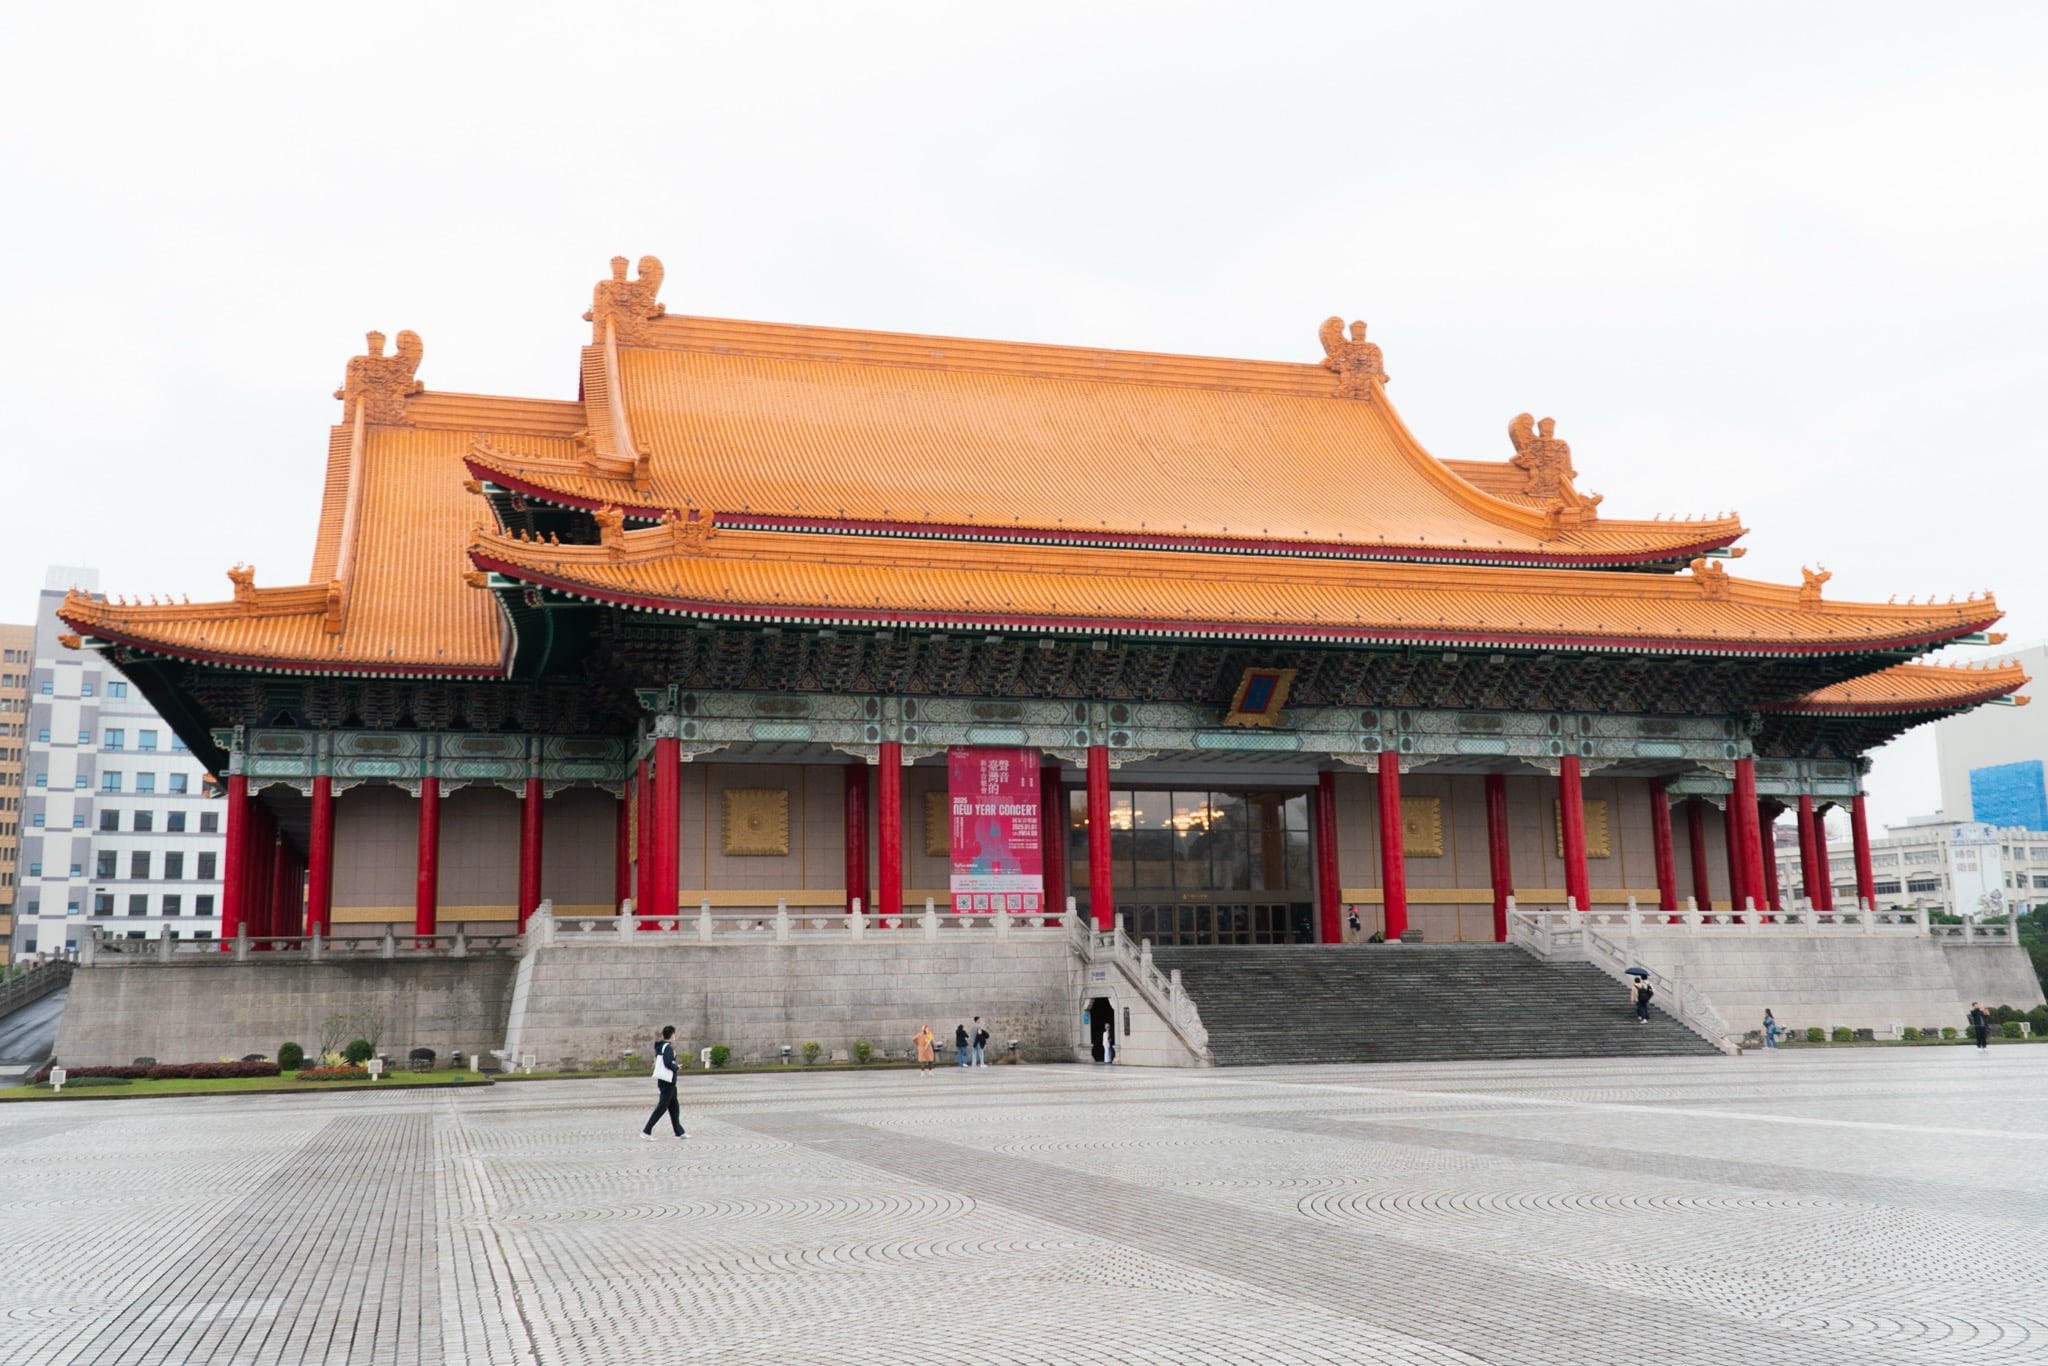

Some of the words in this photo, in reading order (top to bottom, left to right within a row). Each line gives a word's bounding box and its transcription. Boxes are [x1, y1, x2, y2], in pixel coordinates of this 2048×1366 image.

[953, 804, 973, 816] NEW
[975, 804, 997, 816] YEAR
[999, 804, 1038, 816] CONCERT
